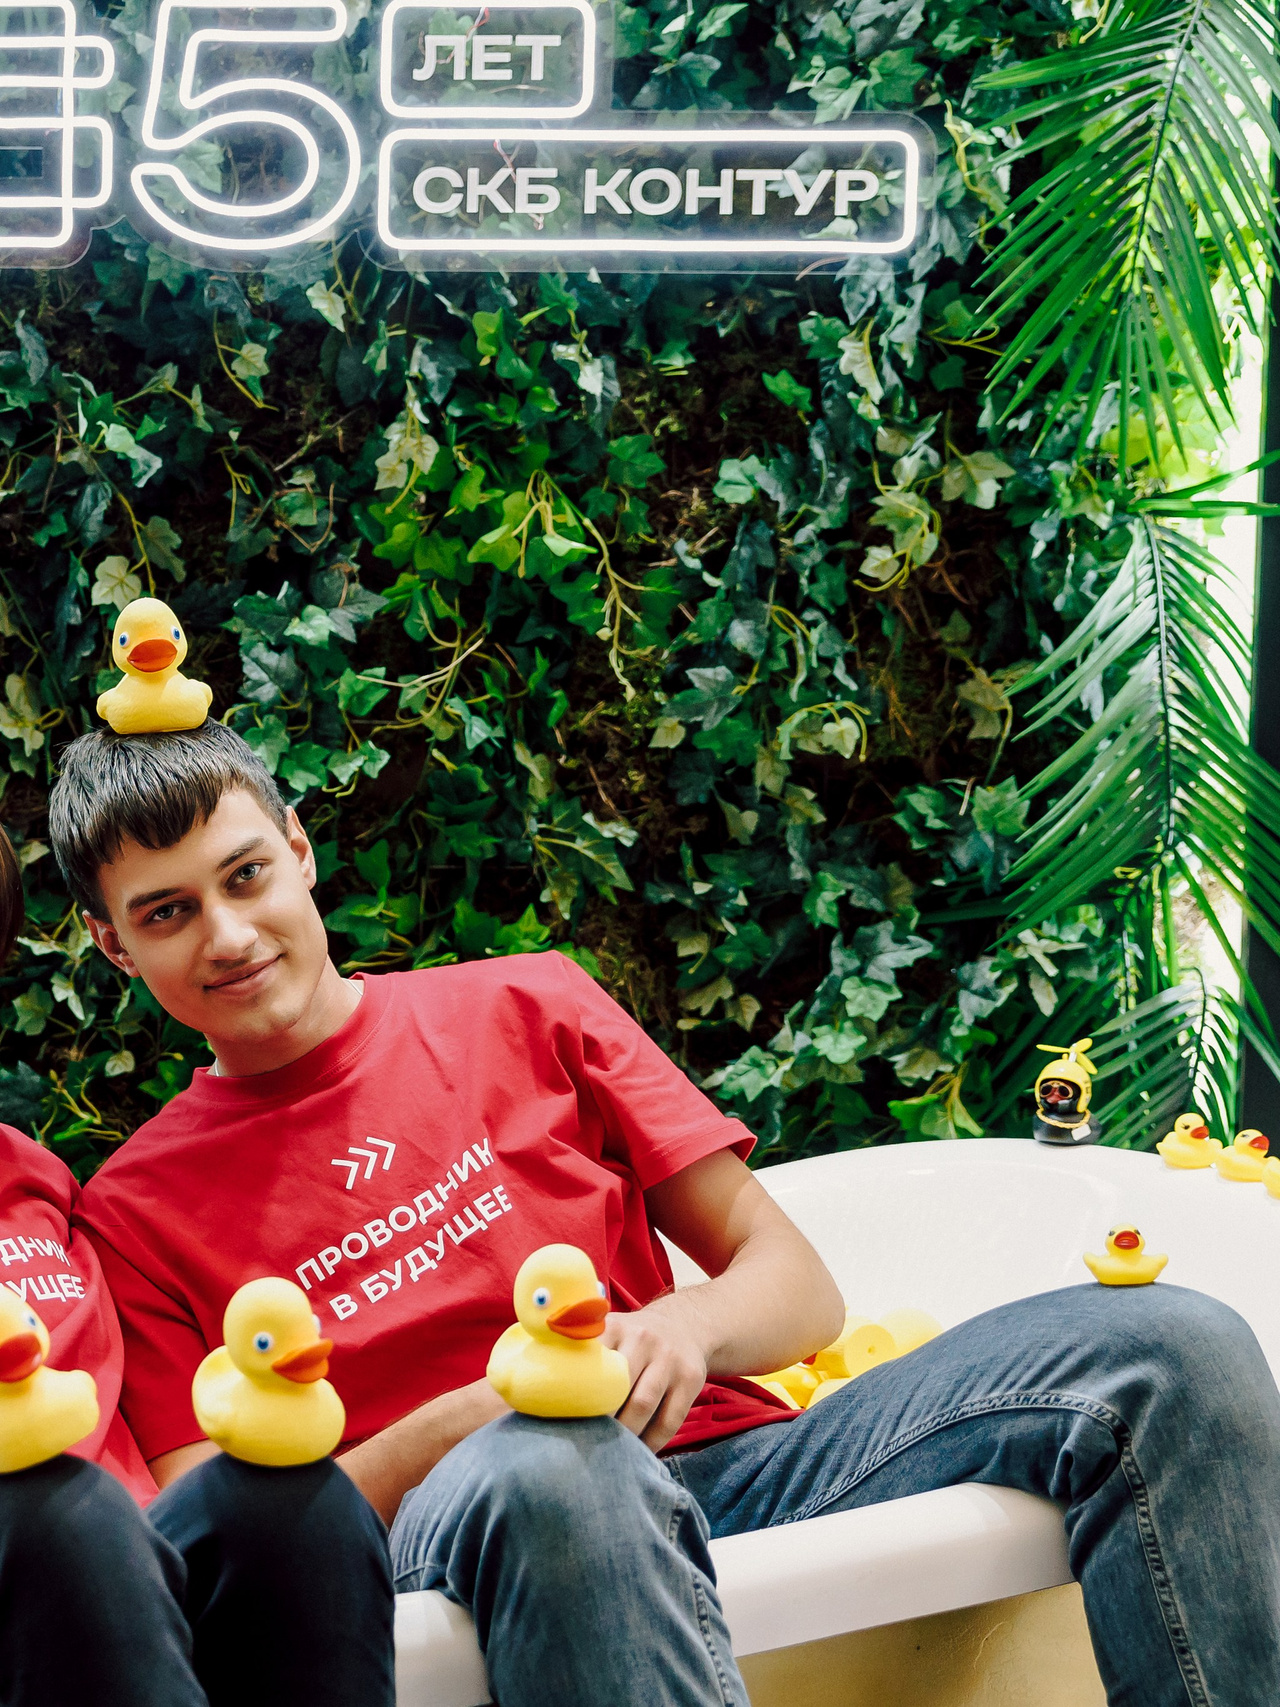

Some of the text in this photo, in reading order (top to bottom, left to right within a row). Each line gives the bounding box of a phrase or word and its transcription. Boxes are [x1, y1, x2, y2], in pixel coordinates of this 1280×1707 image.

[412, 34, 562, 81] ЛЕТ
[412, 166, 880, 216] СКБ КОНТУР
[295, 1137, 495, 1291] ПРОВОДНИК
[328, 1184, 513, 1321] В БУДУЩЕЕ
